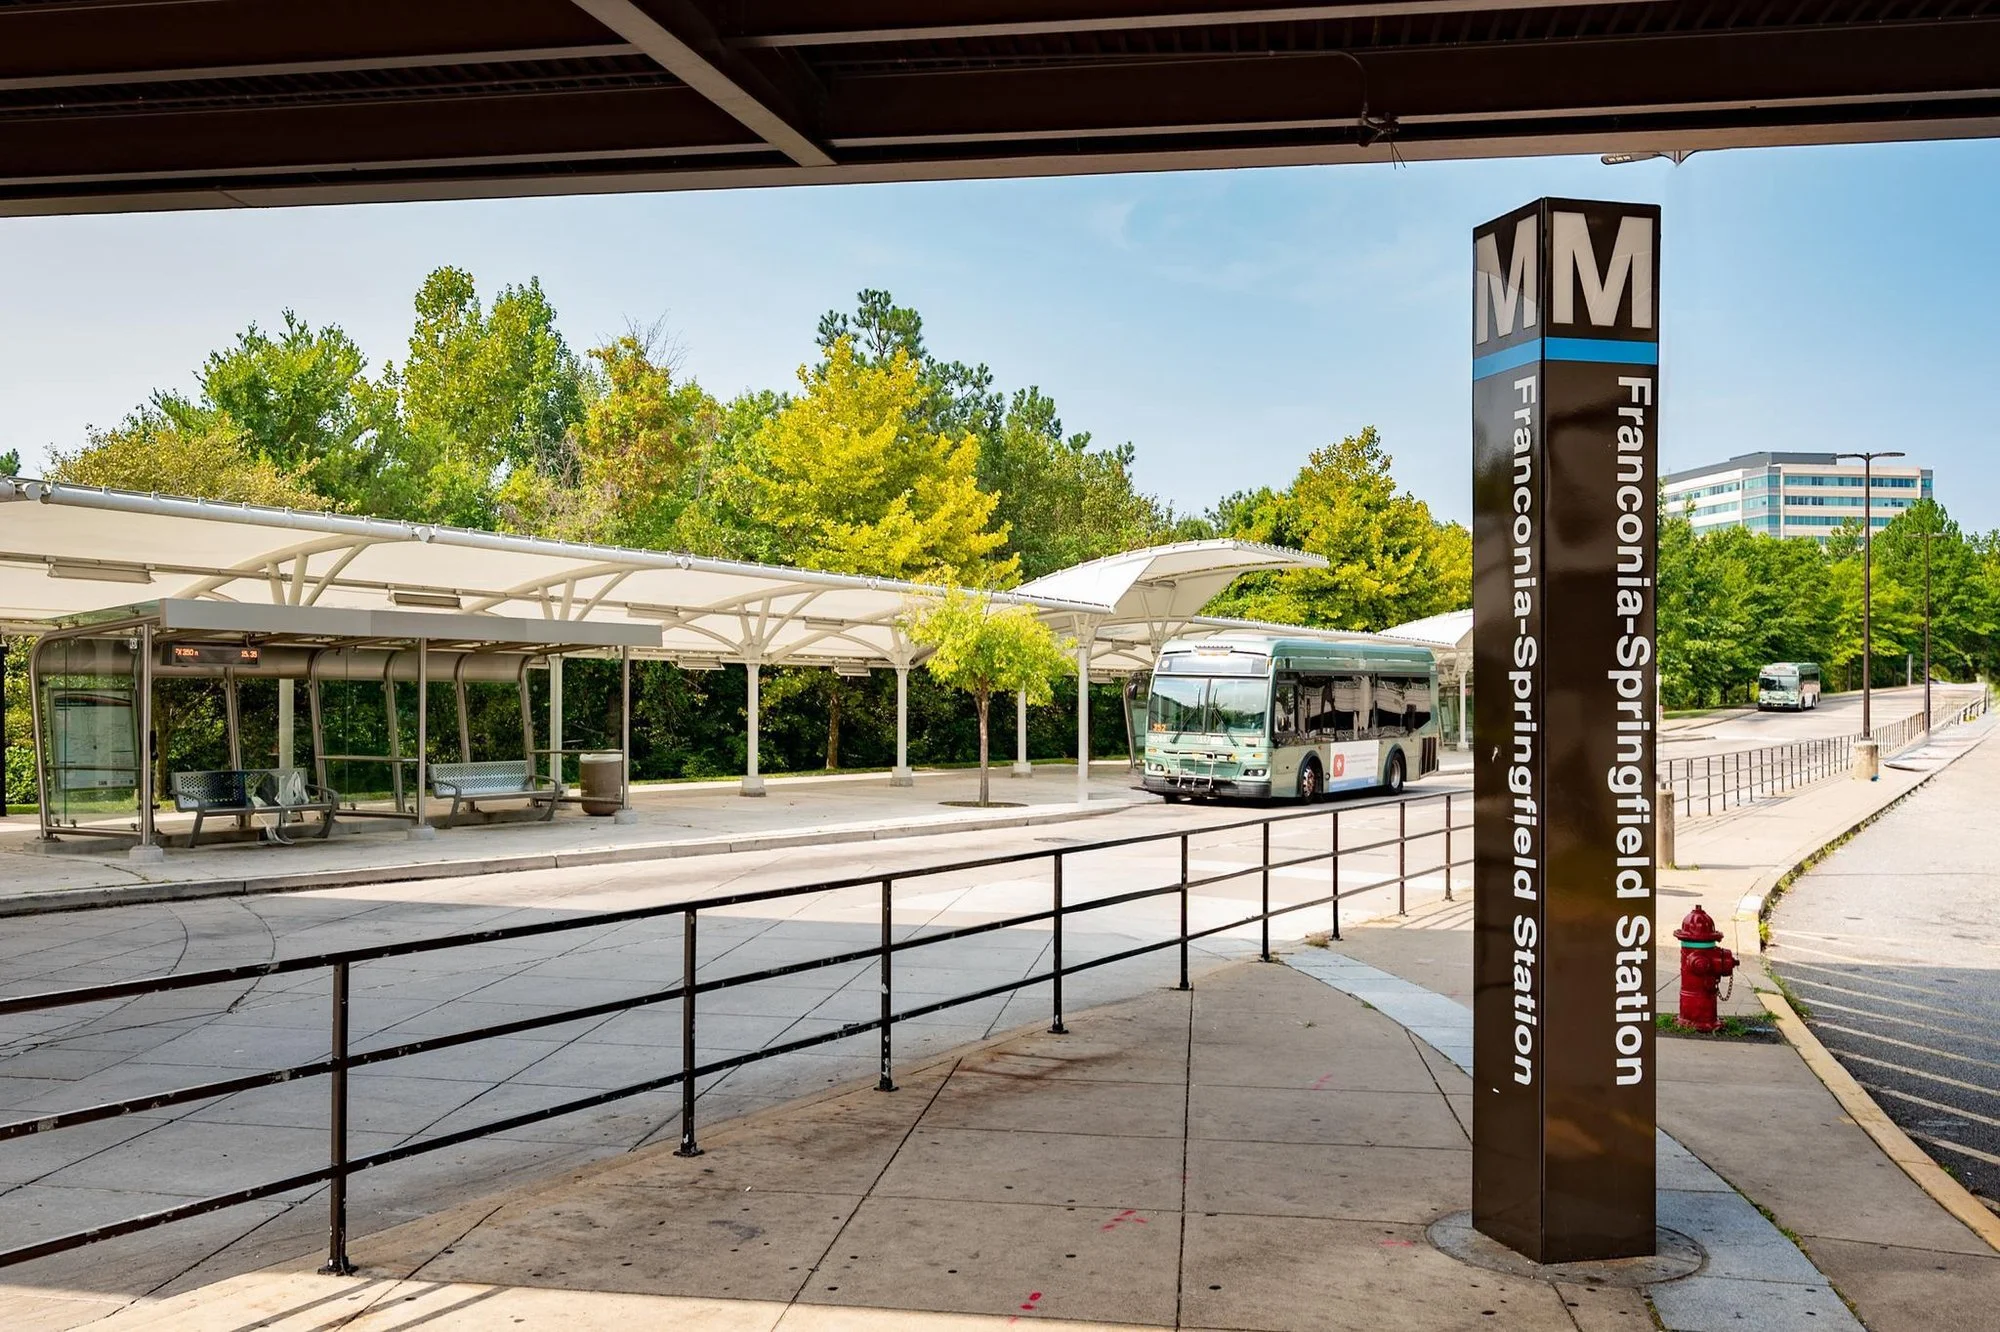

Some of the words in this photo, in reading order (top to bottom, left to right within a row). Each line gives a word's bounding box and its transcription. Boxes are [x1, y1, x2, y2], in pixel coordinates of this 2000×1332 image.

[1475, 213, 1538, 346] M
[1552, 210, 1653, 329] M
[1508, 375, 1538, 901] Franconia-Springfield
[1607, 376, 1652, 899] Franconia-Springfield
[1513, 915, 1538, 1086] Station
[1615, 914, 1651, 1086] Station
